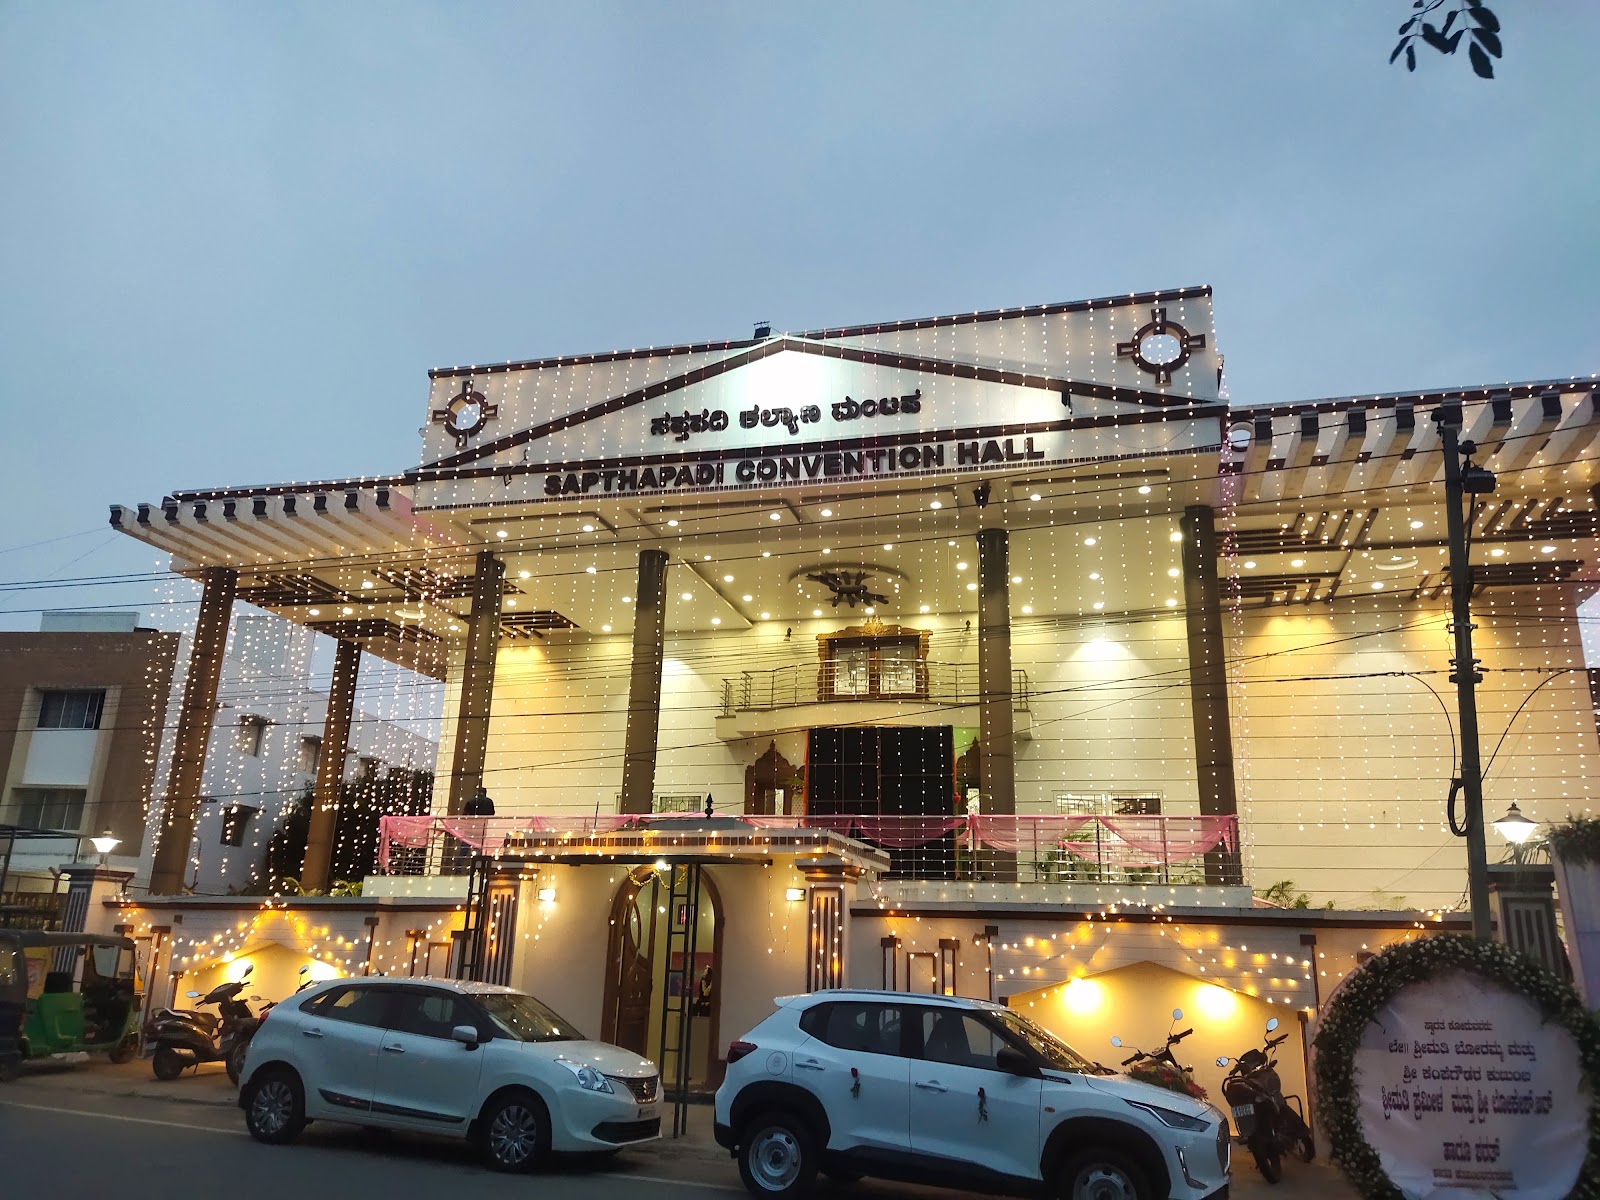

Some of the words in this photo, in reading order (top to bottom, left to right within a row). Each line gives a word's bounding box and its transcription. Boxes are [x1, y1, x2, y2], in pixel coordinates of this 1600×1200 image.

[650, 408, 729, 441] ಸಪ್ತಪದಿ
[739, 404, 822, 436] ಕಲ್ಯಾಣ
[831, 388, 921, 422] ಮಂಟಪ
[543, 461, 725, 496] SAPTHAPADI
[735, 444, 944, 484] CONVENTION
[956, 436, 1045, 466] HALL
[1413, 1040, 1450, 1059] ಶ್ರೀಮತಿ
[1507, 1040, 1536, 1062] ಮತ್ತು
[1403, 1065, 1418, 1083] ಶ್ರೀ
[1382, 1085, 1409, 1120] ಶ್ರೀಮತಿ
